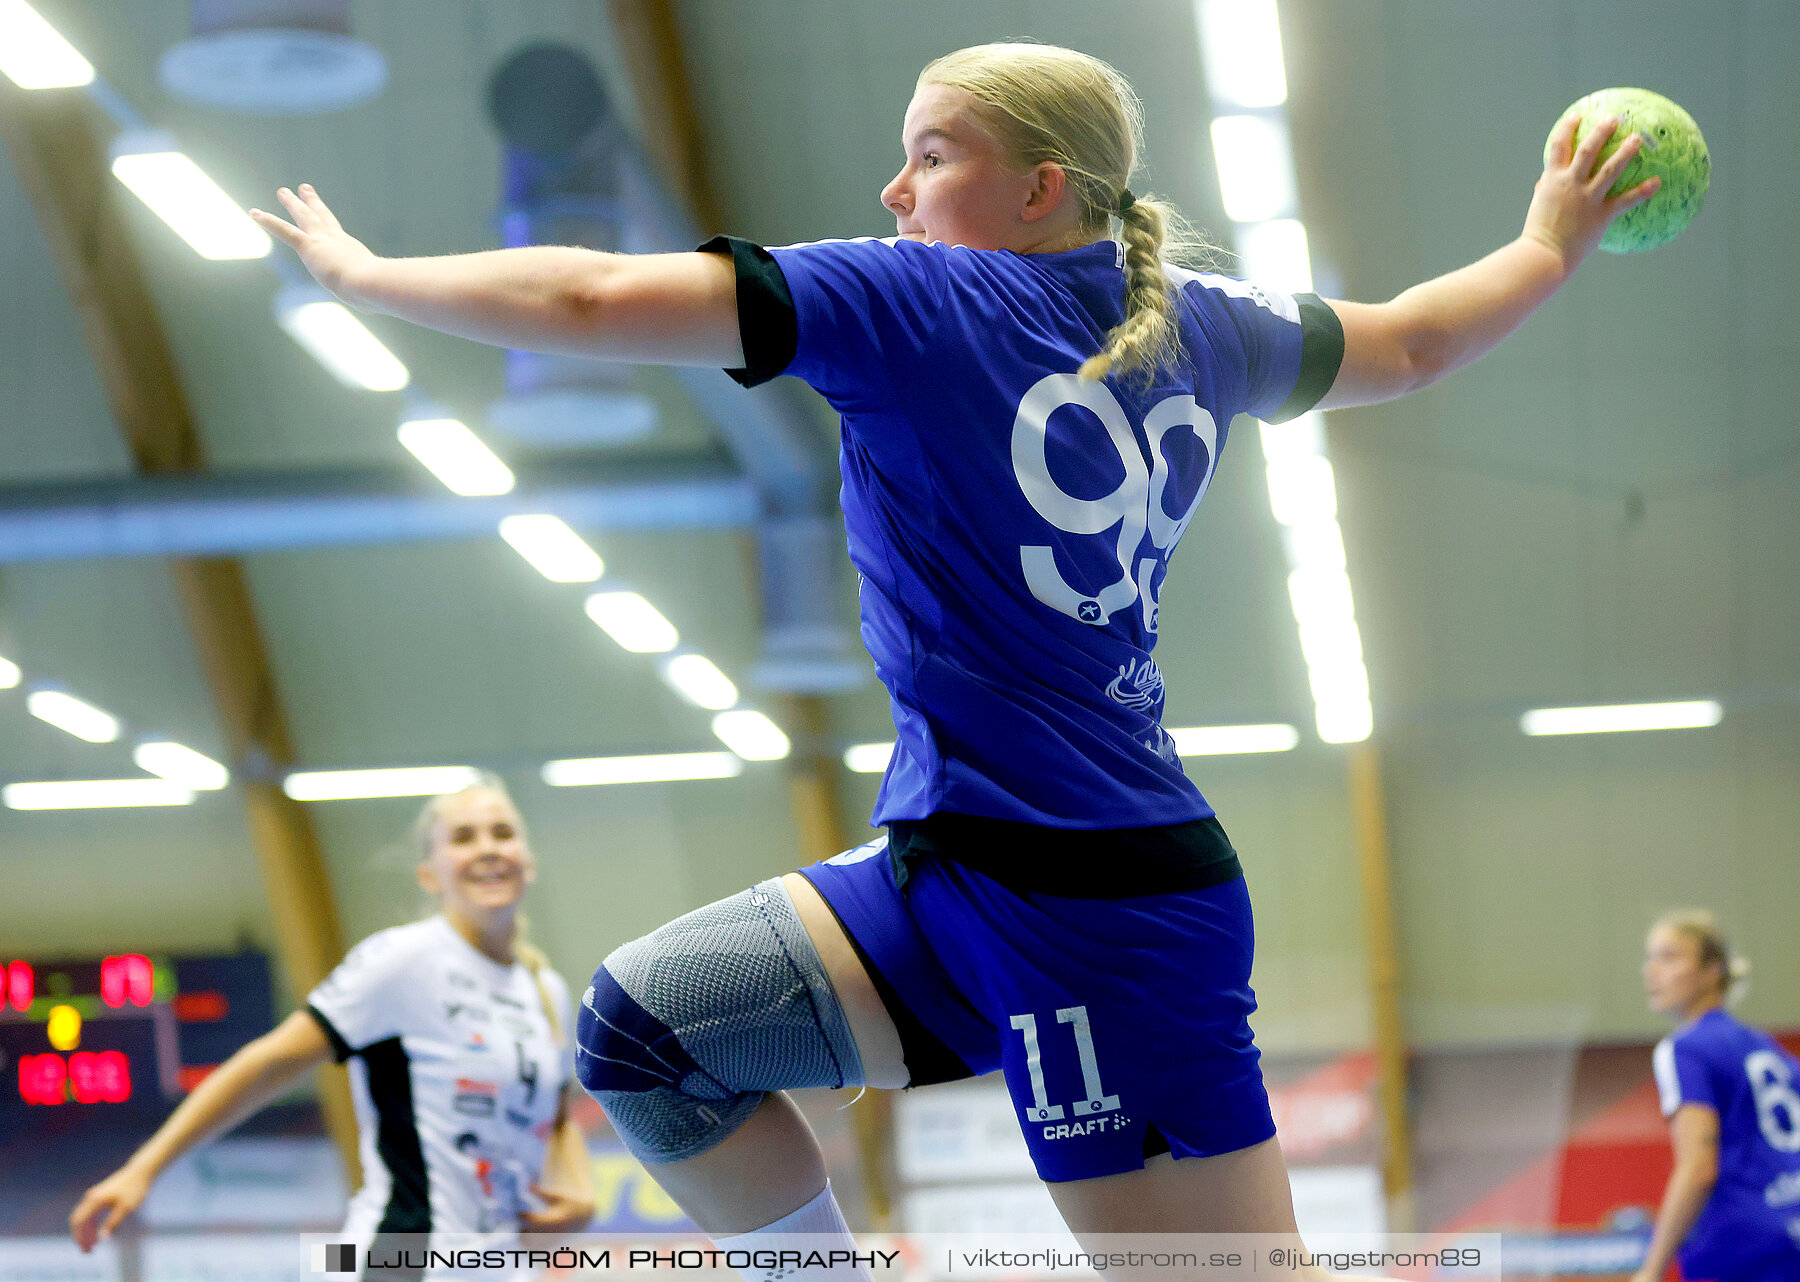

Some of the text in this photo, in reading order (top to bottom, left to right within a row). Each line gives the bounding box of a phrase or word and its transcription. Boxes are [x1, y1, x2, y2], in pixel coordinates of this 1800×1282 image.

[1010, 372, 1218, 634] 99
[1009, 1005, 1121, 1122] 11
[1043, 1117, 1109, 1140] CRAFT
